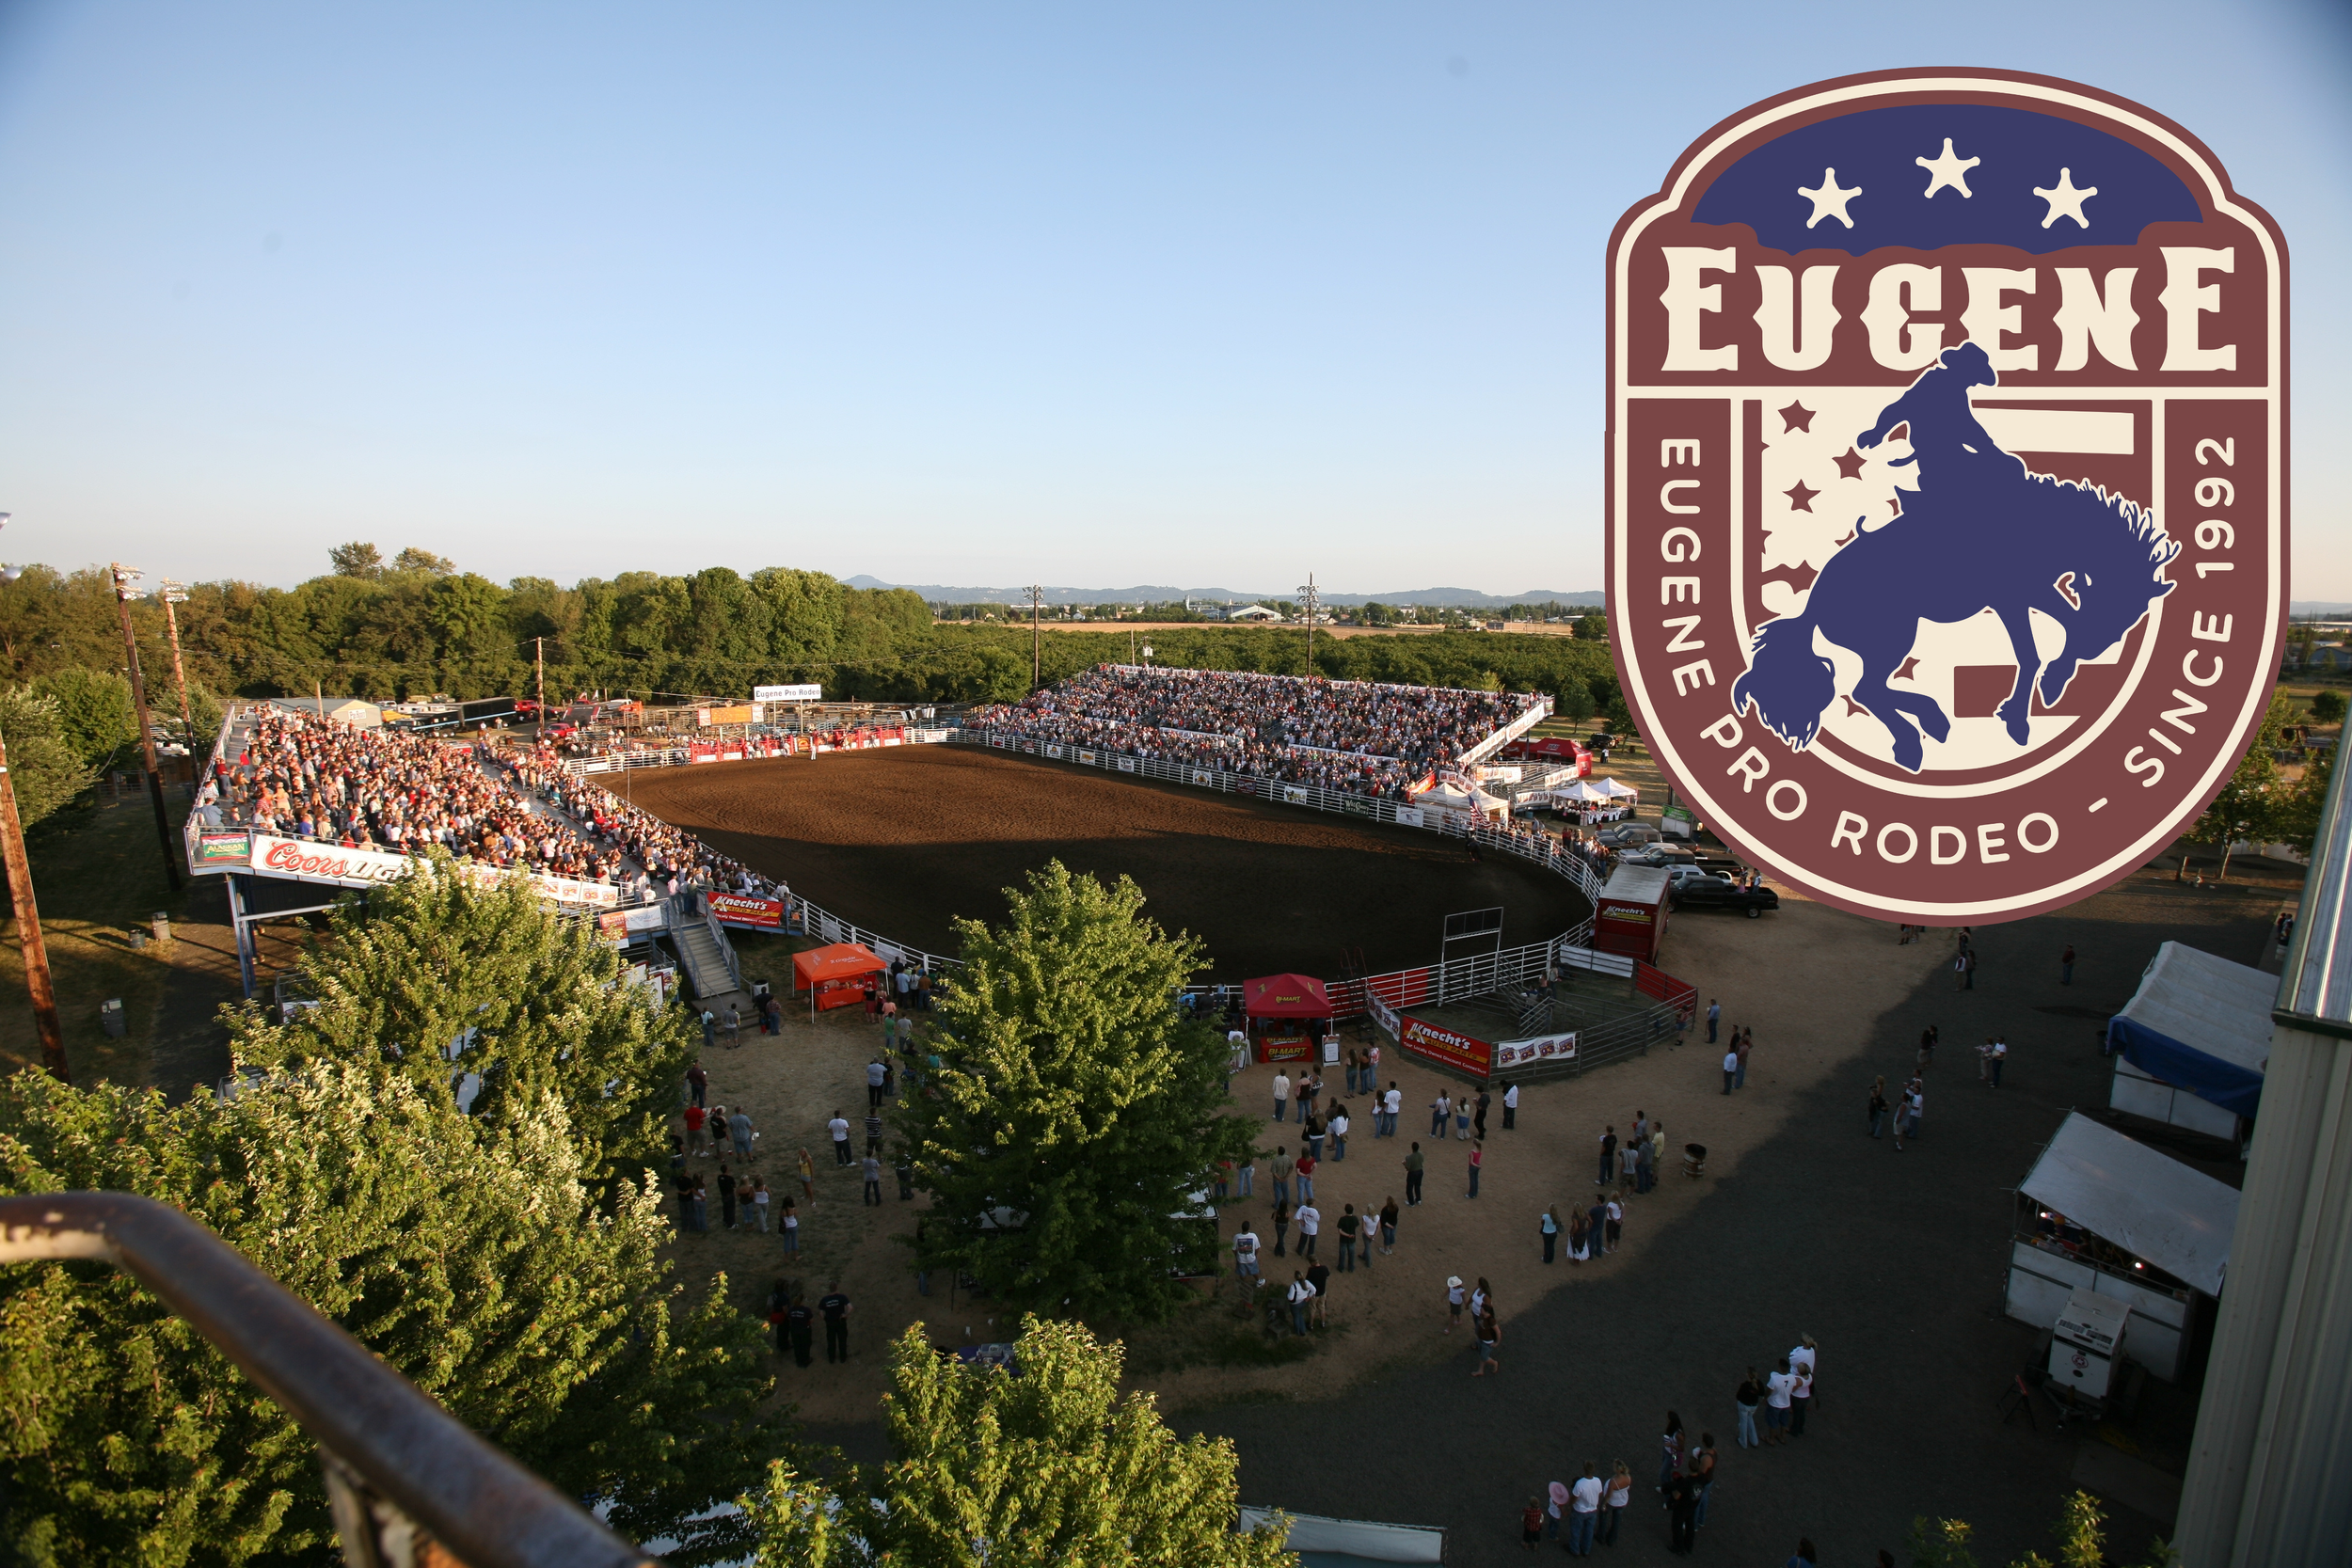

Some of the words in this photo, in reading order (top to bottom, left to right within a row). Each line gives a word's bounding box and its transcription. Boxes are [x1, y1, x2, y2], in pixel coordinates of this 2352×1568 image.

[755, 690, 783, 699] Eugene
[264, 841, 348, 877] Coors
[346, 860, 406, 882] LIG
[710, 895, 768, 912] Knecht's
[1604, 905, 1645, 917] Knecht's
[1406, 1022, 1471, 1051] Knecht's
[1426, 1039, 1448, 1051] AUTO
[1451, 1047, 1478, 1061] PARTS
[1540, 1045, 1555, 1056] 93
[1559, 1041, 1574, 1053] 93
[1501, 1051, 1516, 1063] 93
[1521, 1048, 1535, 1060] 93
